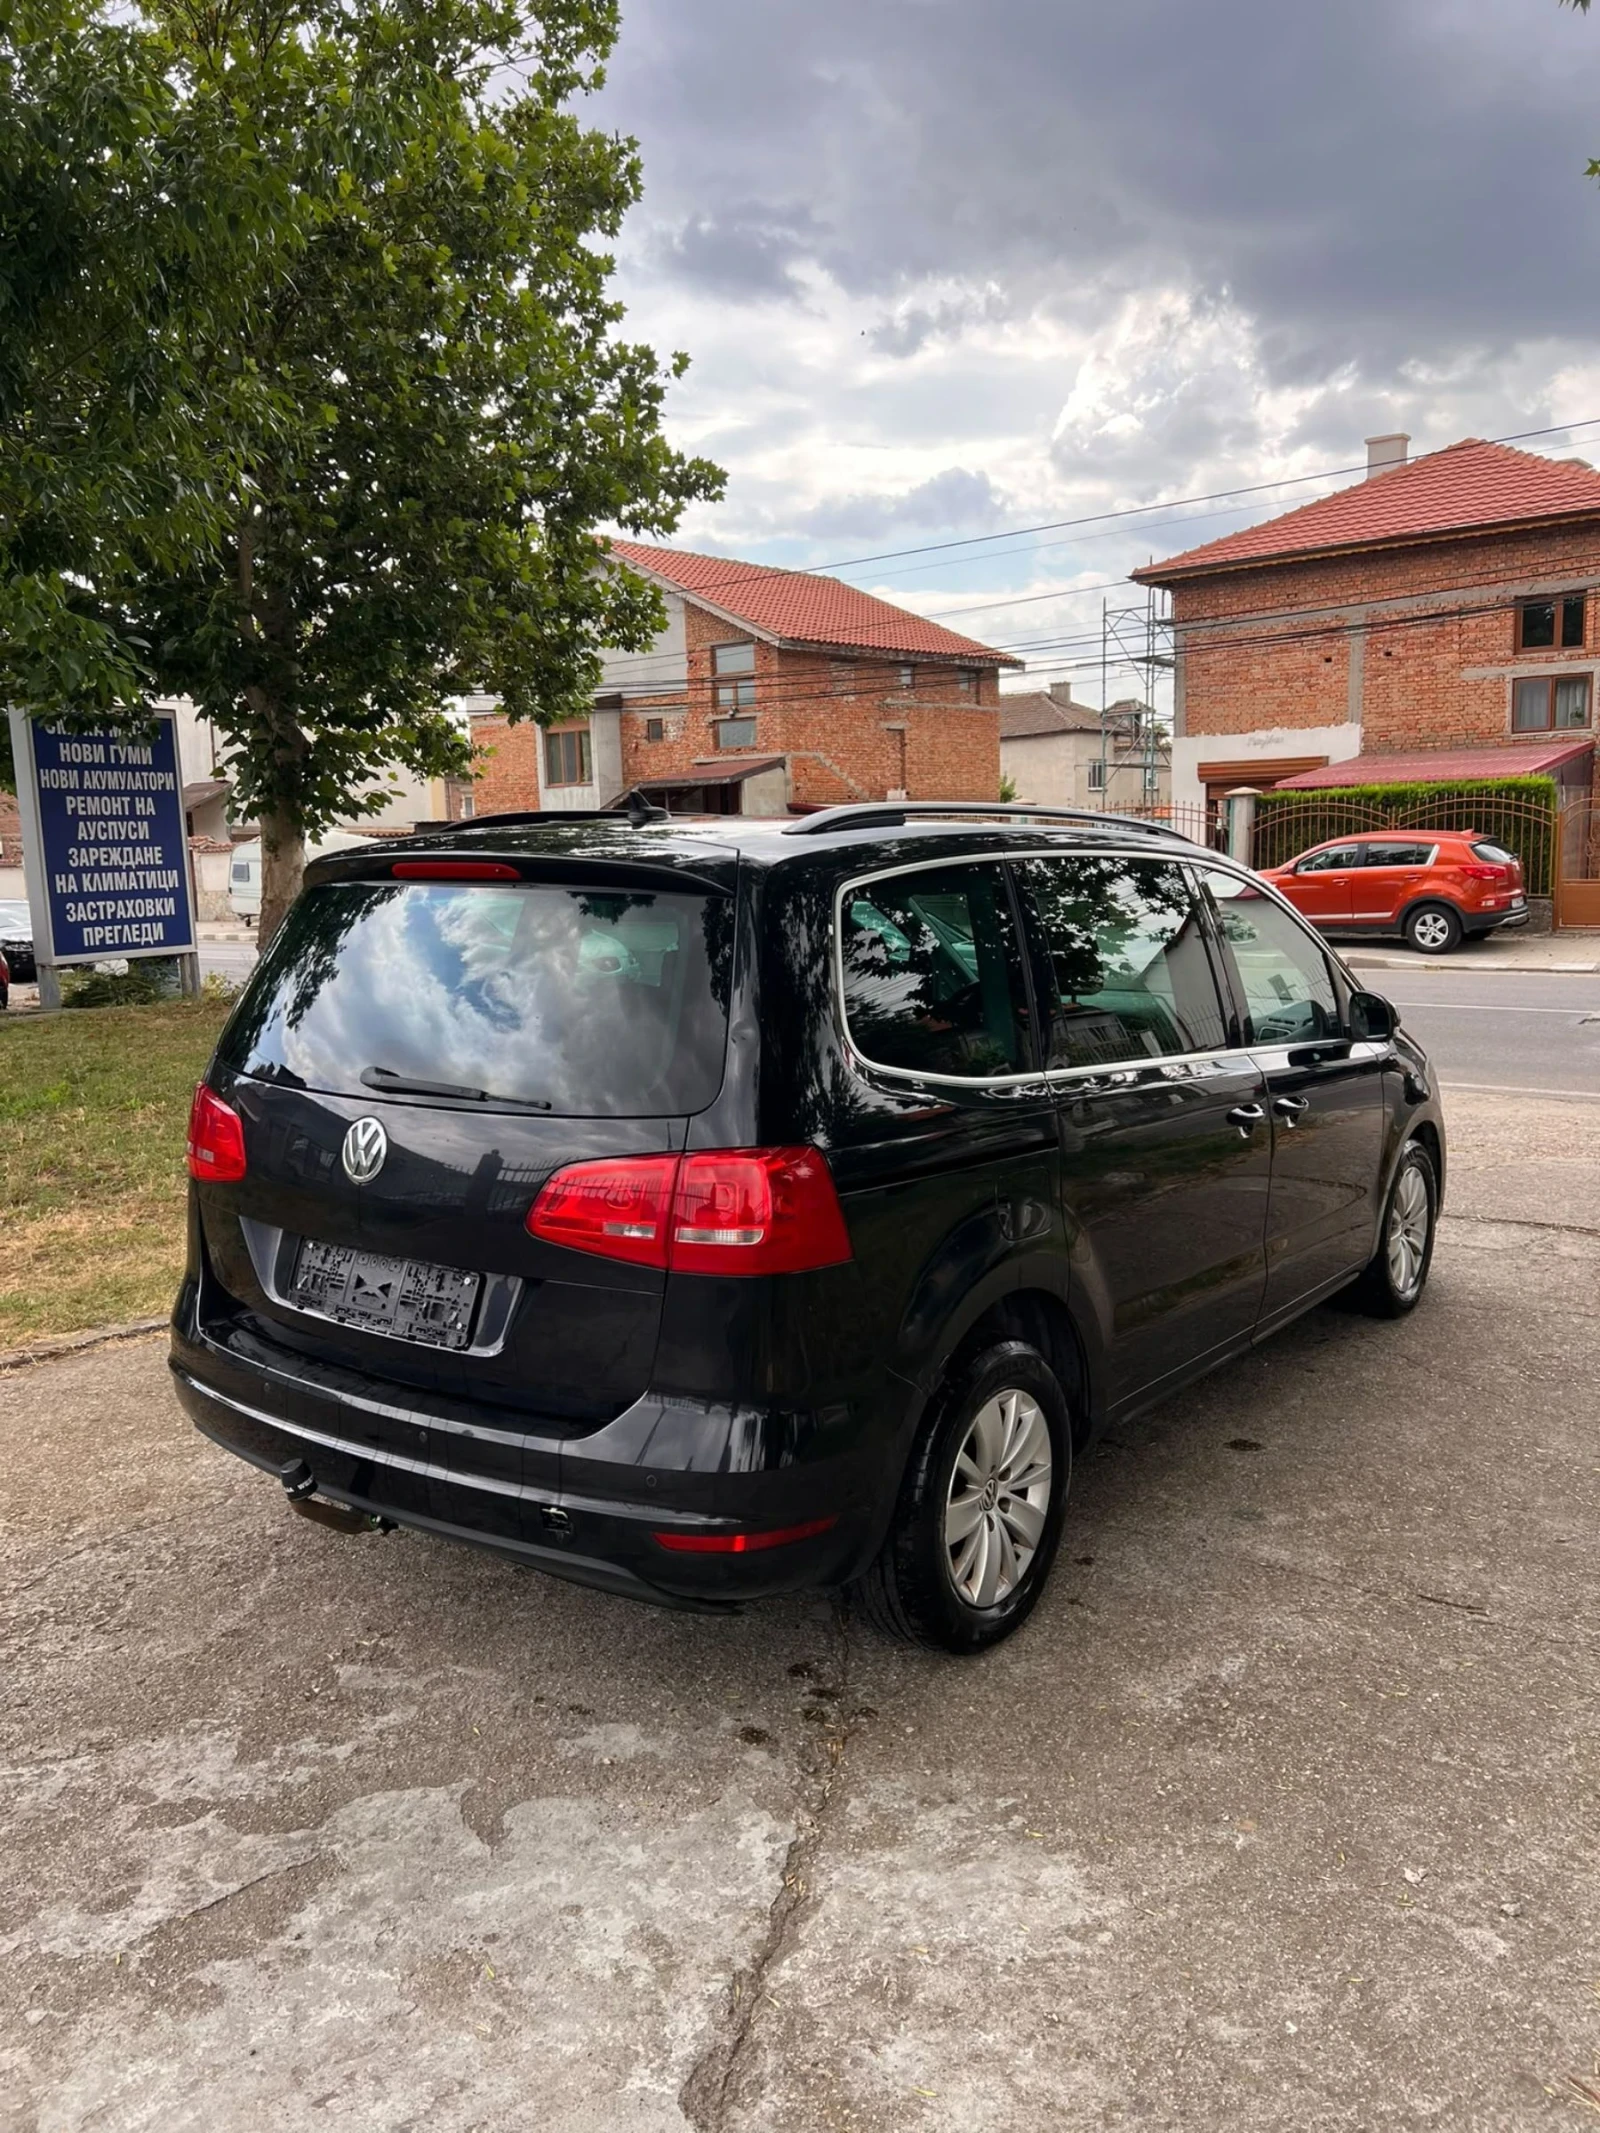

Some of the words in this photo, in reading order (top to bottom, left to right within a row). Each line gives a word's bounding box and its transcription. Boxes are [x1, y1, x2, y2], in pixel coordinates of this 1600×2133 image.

[59, 742, 105, 763] НОВИ
[109, 744, 153, 765] ГУМИ
[40, 768, 79, 789] НОВИ
[83, 770, 175, 791] АКУМУЛАТОРИ
[65, 796, 130, 816] РЕМОНТ
[135, 797, 156, 816] НА
[77, 821, 149, 840] АУСПУСИ
[68, 846, 163, 869] ЗАРЕЖДАНЕ
[55, 873, 78, 894] НА
[82, 869, 179, 892] КЛИМАТИЦИ
[65, 897, 176, 922] ЗАСТРАХОВКИ
[82, 922, 164, 946] ПРЕГЛЕДИ
